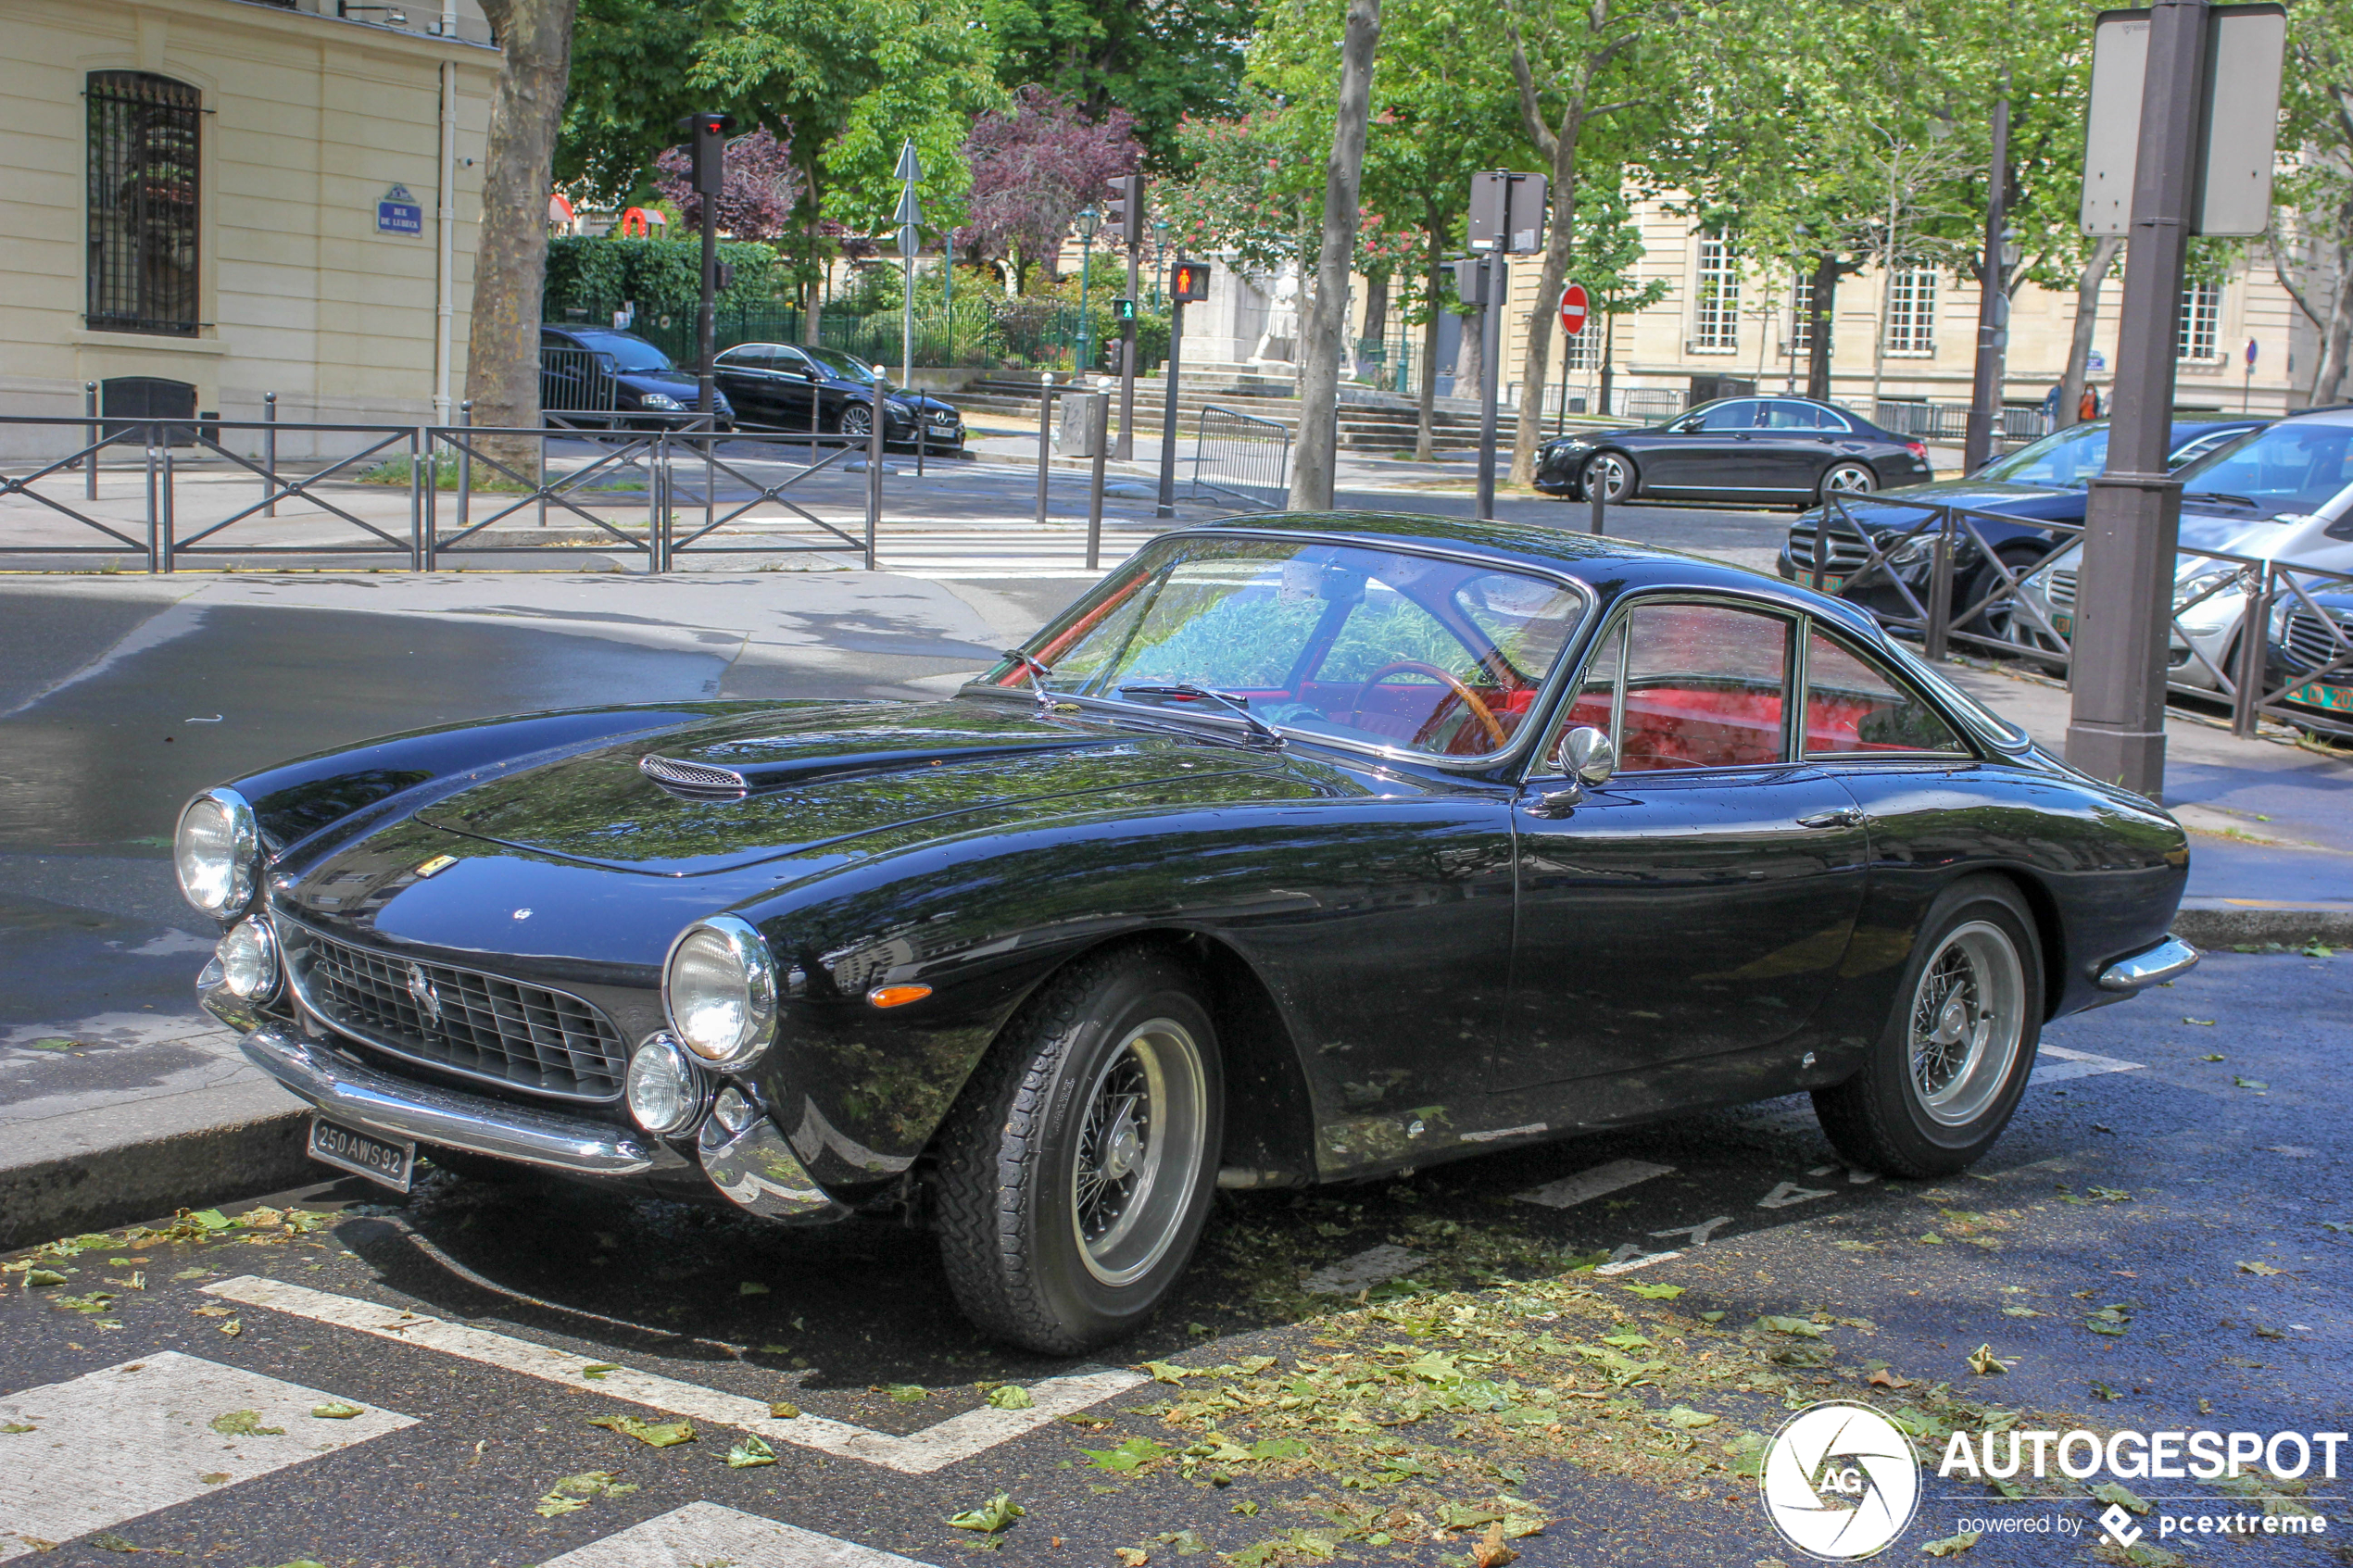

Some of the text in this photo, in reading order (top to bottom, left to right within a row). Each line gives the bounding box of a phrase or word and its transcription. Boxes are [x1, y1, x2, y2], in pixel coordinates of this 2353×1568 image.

[394, 207, 407, 217] RUE
[380, 217, 420, 229] DE LUBECK
